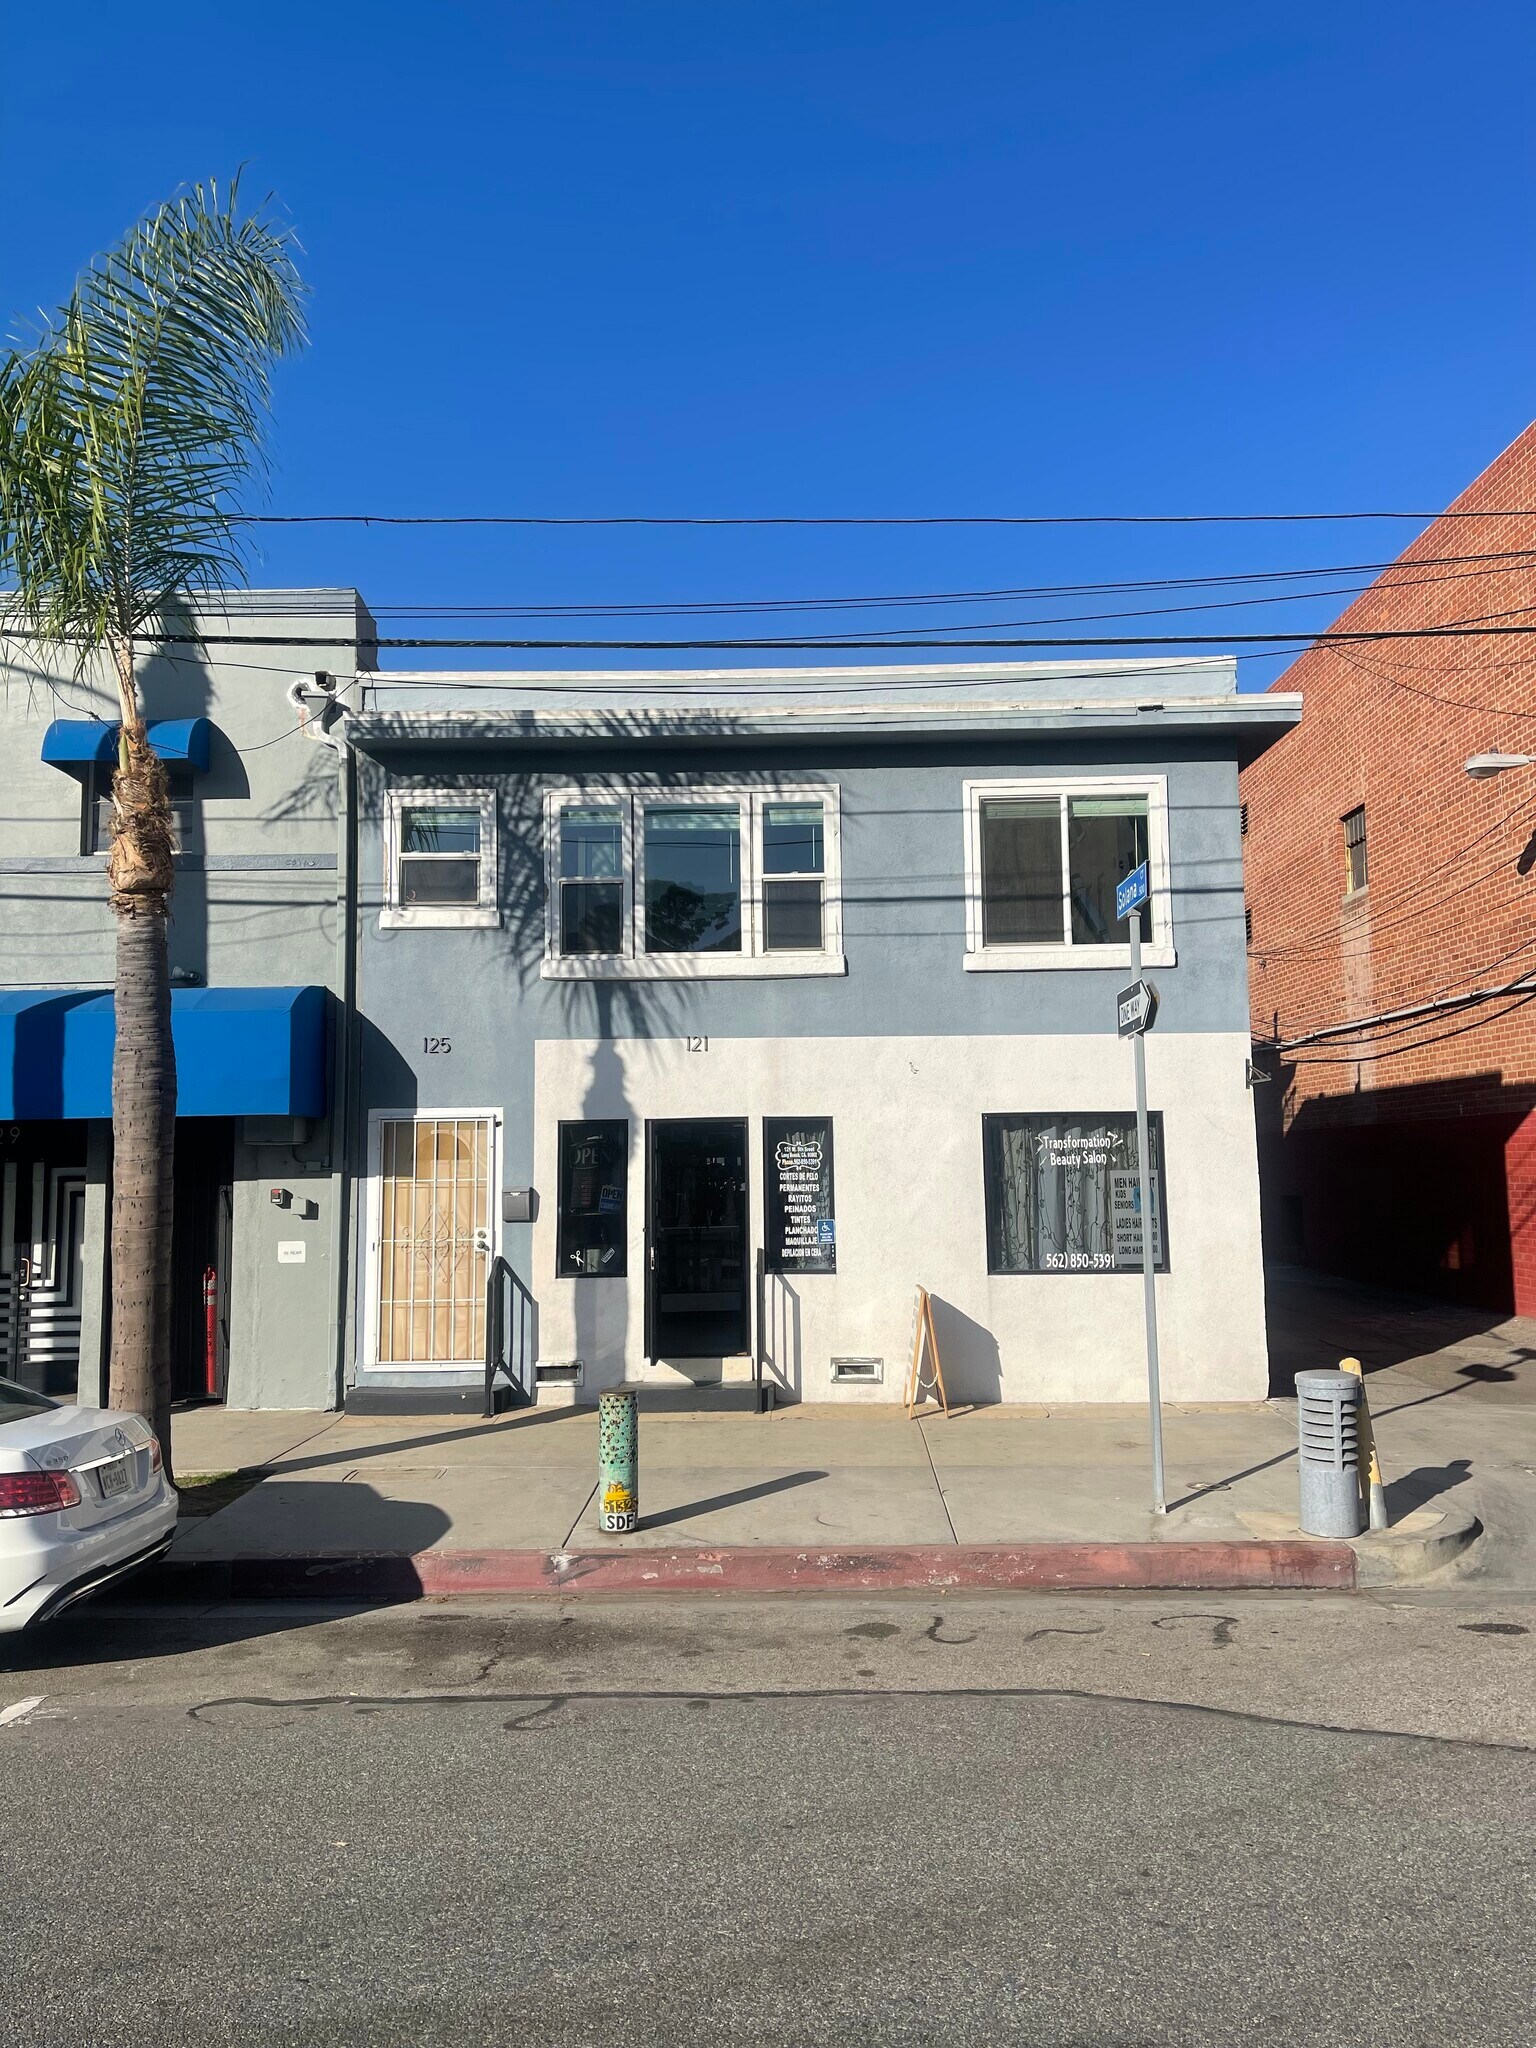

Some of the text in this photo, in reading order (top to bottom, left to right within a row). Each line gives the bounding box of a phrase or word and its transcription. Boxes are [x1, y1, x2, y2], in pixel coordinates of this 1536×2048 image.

[1118, 882, 1137, 912] Solana
[1120, 1003, 1130, 1025] ONE
[423, 1037, 451, 1054] 125
[686, 1036, 708, 1053] 121
[1043, 1136, 1111, 1151] Transformation
[1050, 1151, 1107, 1168] Beauty Salon
[779, 1172, 819, 1181] CORTES DE PELO
[779, 1183, 820, 1192] PERMANENTES
[1114, 1177, 1127, 1189] MEN
[602, 1187, 624, 1201] OPEN
[788, 1194, 812, 1203] RAYITOS
[1115, 1189, 1126, 1199] KIDS
[784, 1204, 817, 1213] PEINADOS
[1114, 1200, 1135, 1210] SENIORS
[790, 1215, 811, 1224] TINTES
[1115, 1217, 1131, 1229] LADIES
[785, 1226, 818, 1235] PLANCHADO
[785, 1236, 818, 1246] MAQUILLAJE
[1116, 1233, 1132, 1243] SHORT
[781, 1248, 804, 1258] DEPILACION
[804, 1248, 811, 1256] EN
[811, 1247, 822, 1256] CERA
[1118, 1246, 1131, 1255] LONG
[1046, 1252, 1115, 1270] 562) 850-5391
[52, 1455, 69, 1465] 350
[607, 1514, 634, 1530] SDF
